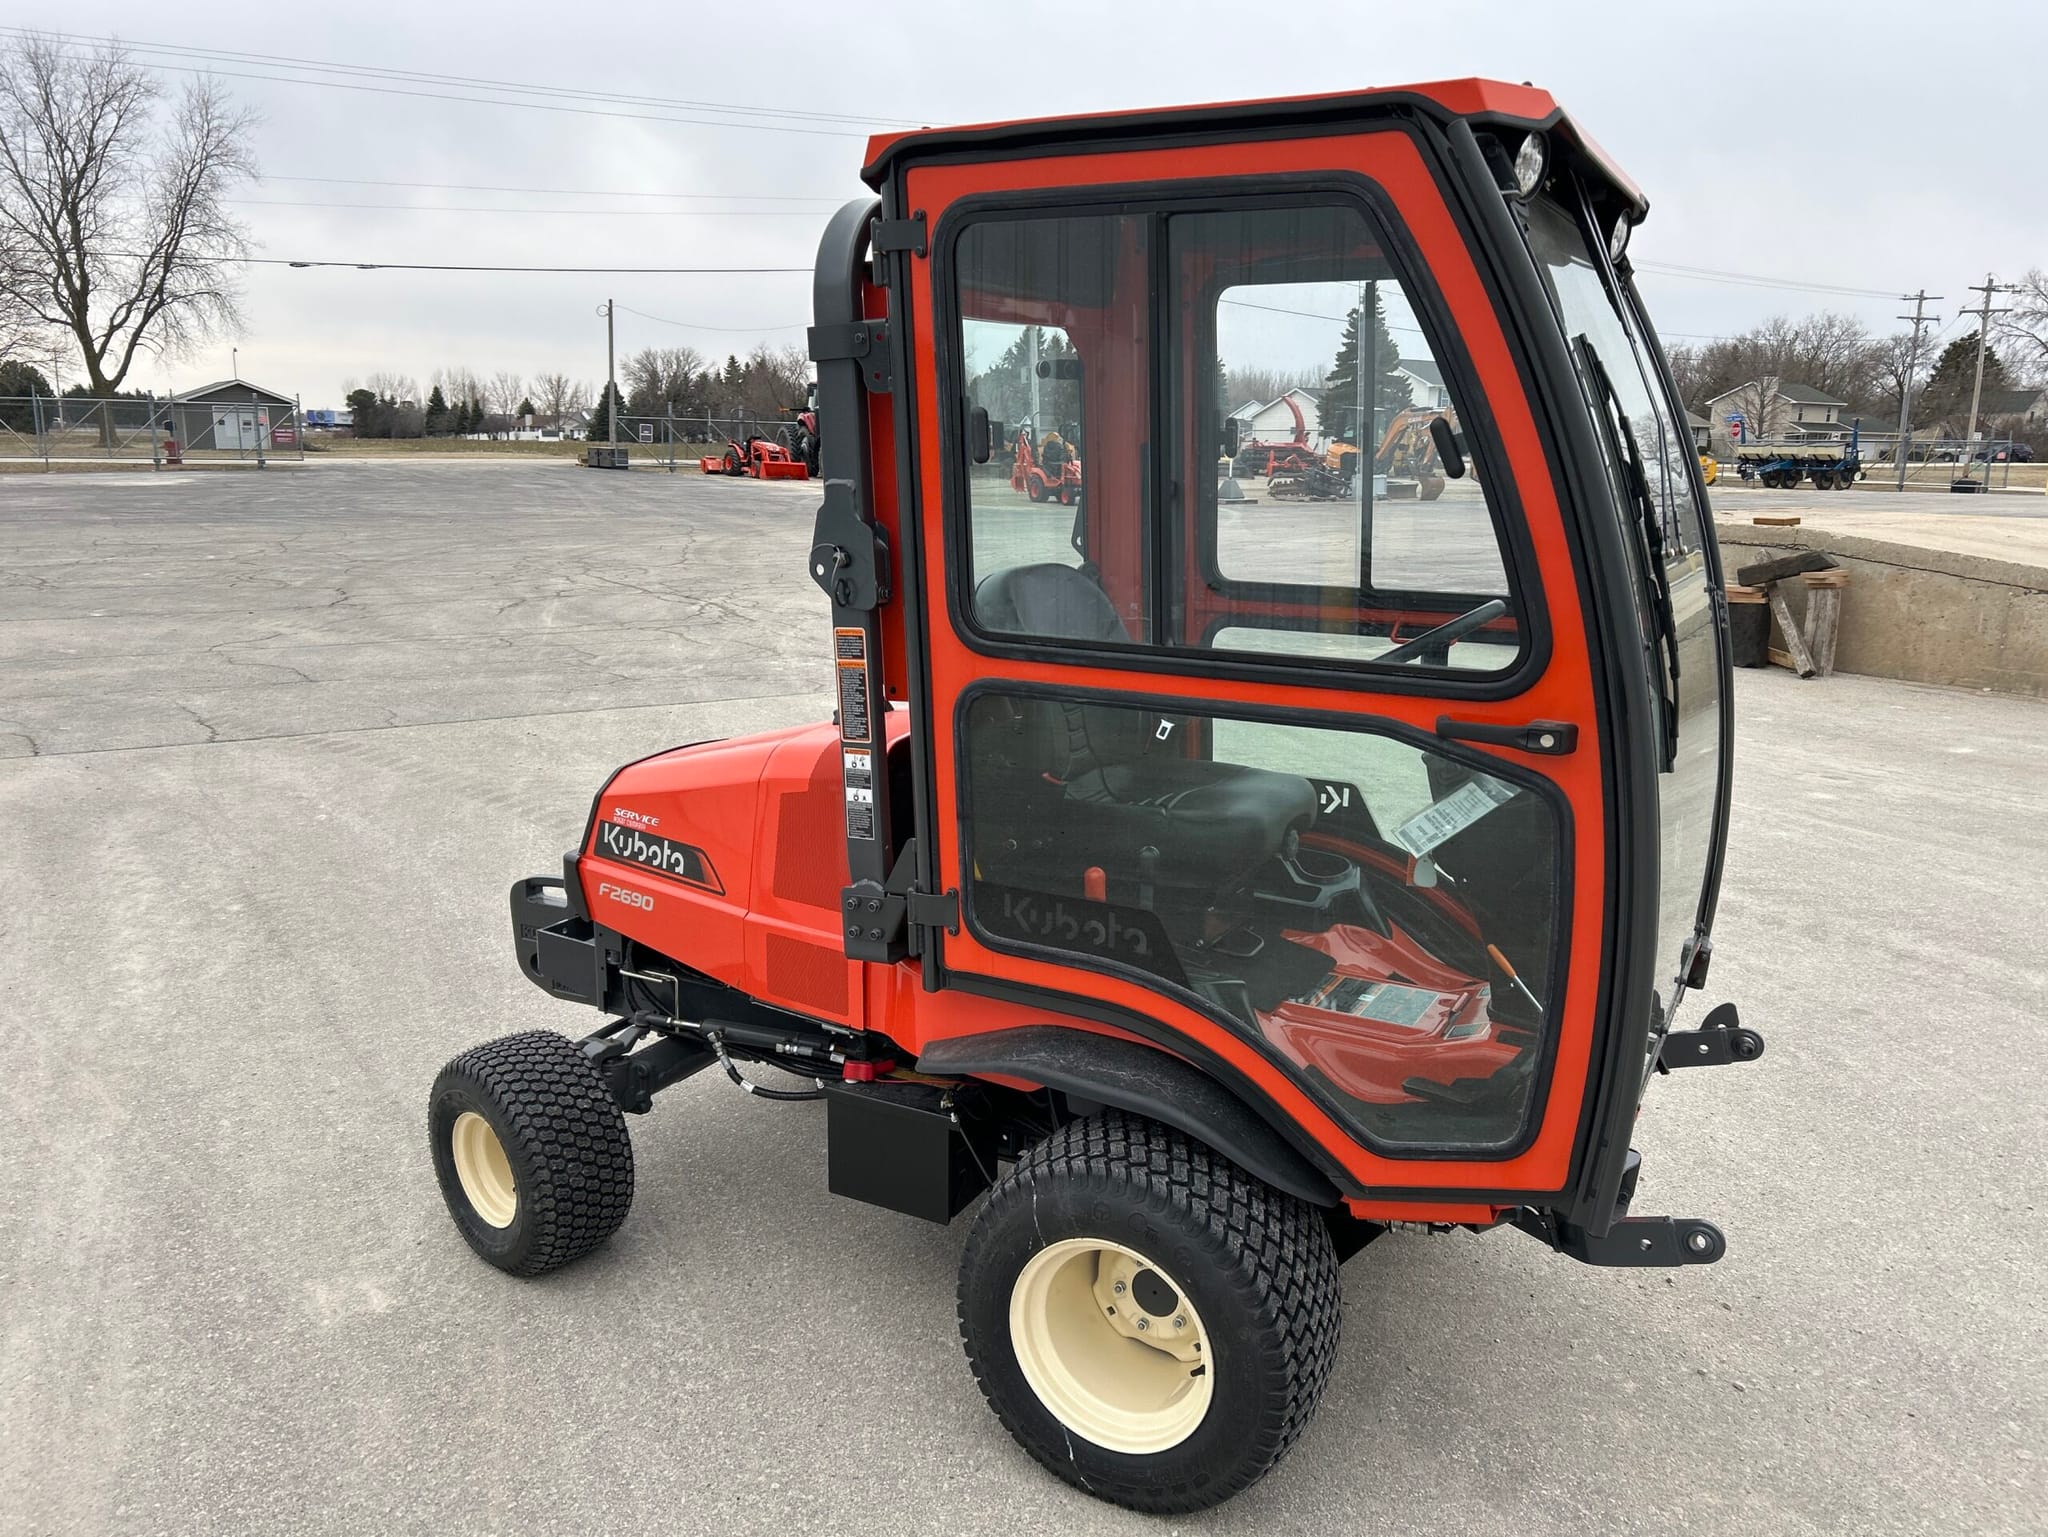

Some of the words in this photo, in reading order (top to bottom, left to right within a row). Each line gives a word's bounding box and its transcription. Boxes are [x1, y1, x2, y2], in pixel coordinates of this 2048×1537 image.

[613, 807, 660, 826] SERVICE
[604, 823, 684, 874] Kubota
[599, 883, 654, 911] F2690
[1003, 892, 1148, 955] Kubota
